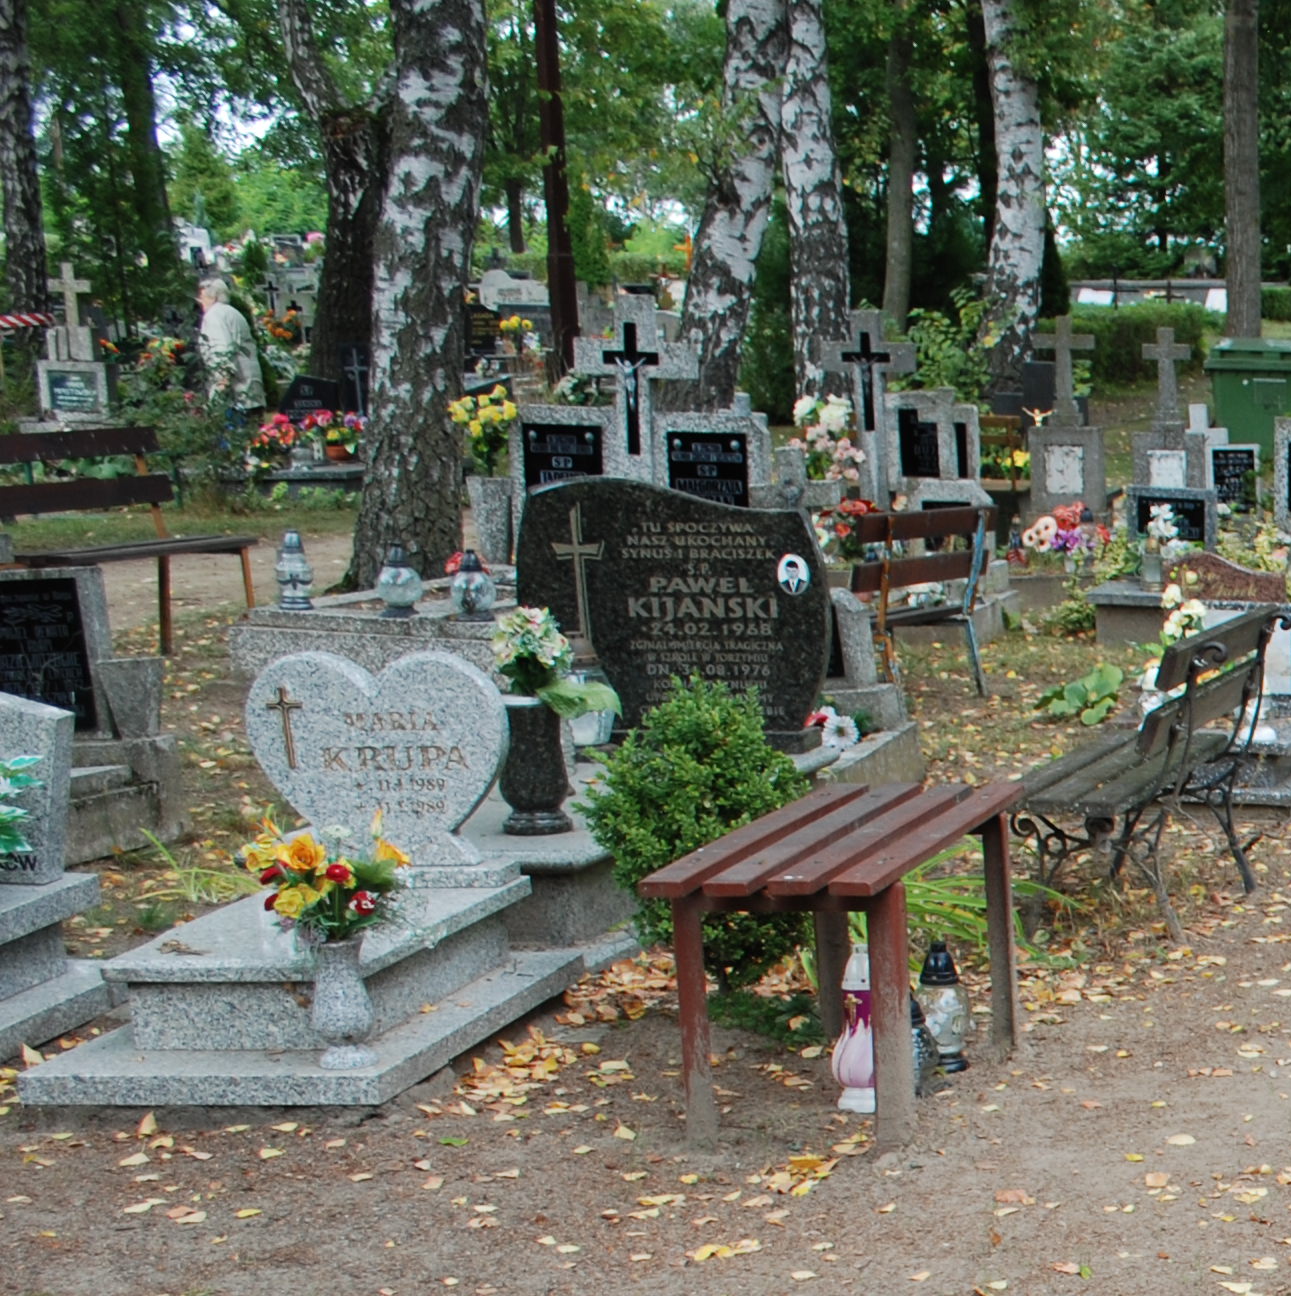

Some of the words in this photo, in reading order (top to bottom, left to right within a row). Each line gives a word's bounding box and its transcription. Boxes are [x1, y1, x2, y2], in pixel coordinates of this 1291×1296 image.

[667, 522, 754, 534] SPOCZYWA
[627, 535, 668, 547] NASZ
[674, 535, 767, 547] UKOCHANY
[689, 549, 776, 560] BRACISZEK
[649, 576, 755, 594] PAWEŁ
[627, 593, 779, 621] KIJAŃSKI
[344, 711, 440, 732] MARIA
[320, 745, 470, 772] KRUPA
